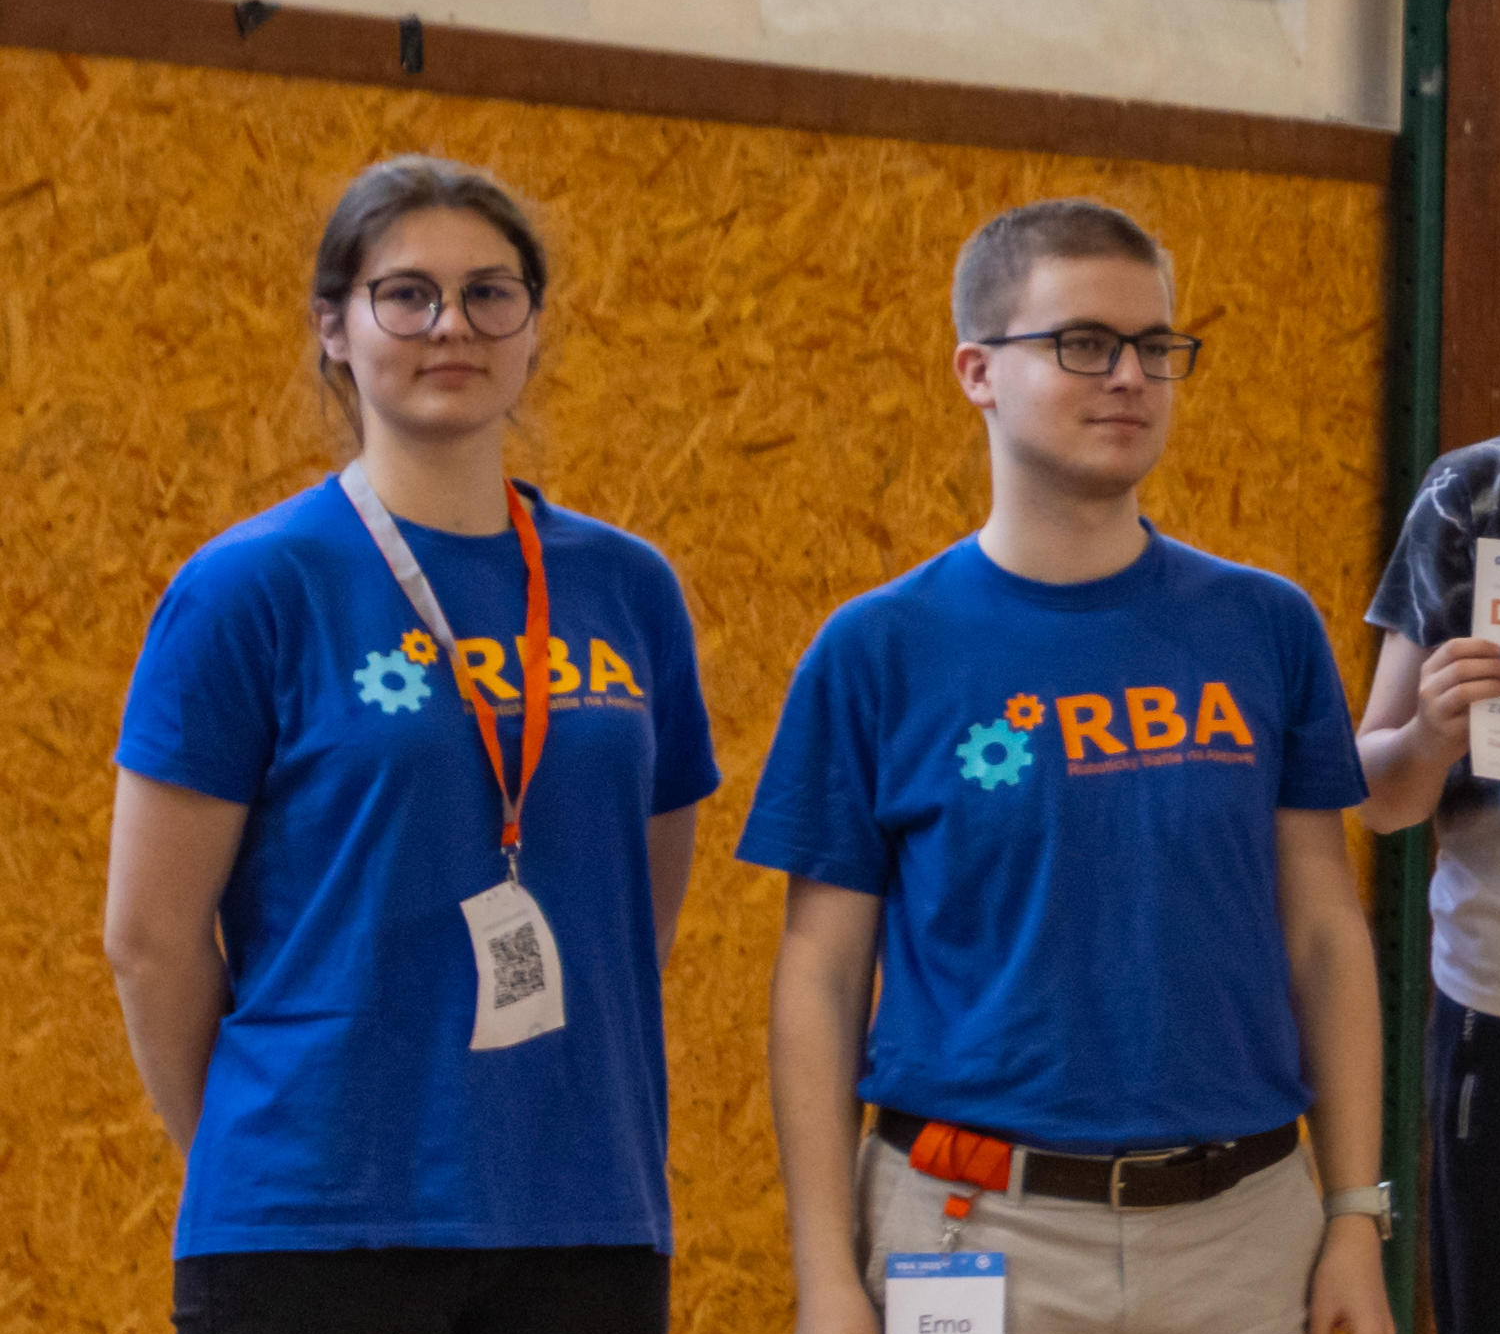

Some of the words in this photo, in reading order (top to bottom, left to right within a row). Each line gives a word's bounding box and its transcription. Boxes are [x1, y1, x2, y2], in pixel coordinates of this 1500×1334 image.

[452, 635, 645, 700] RBA
[1055, 681, 1254, 760] RBA
[918, 1314, 973, 1334] Emo
